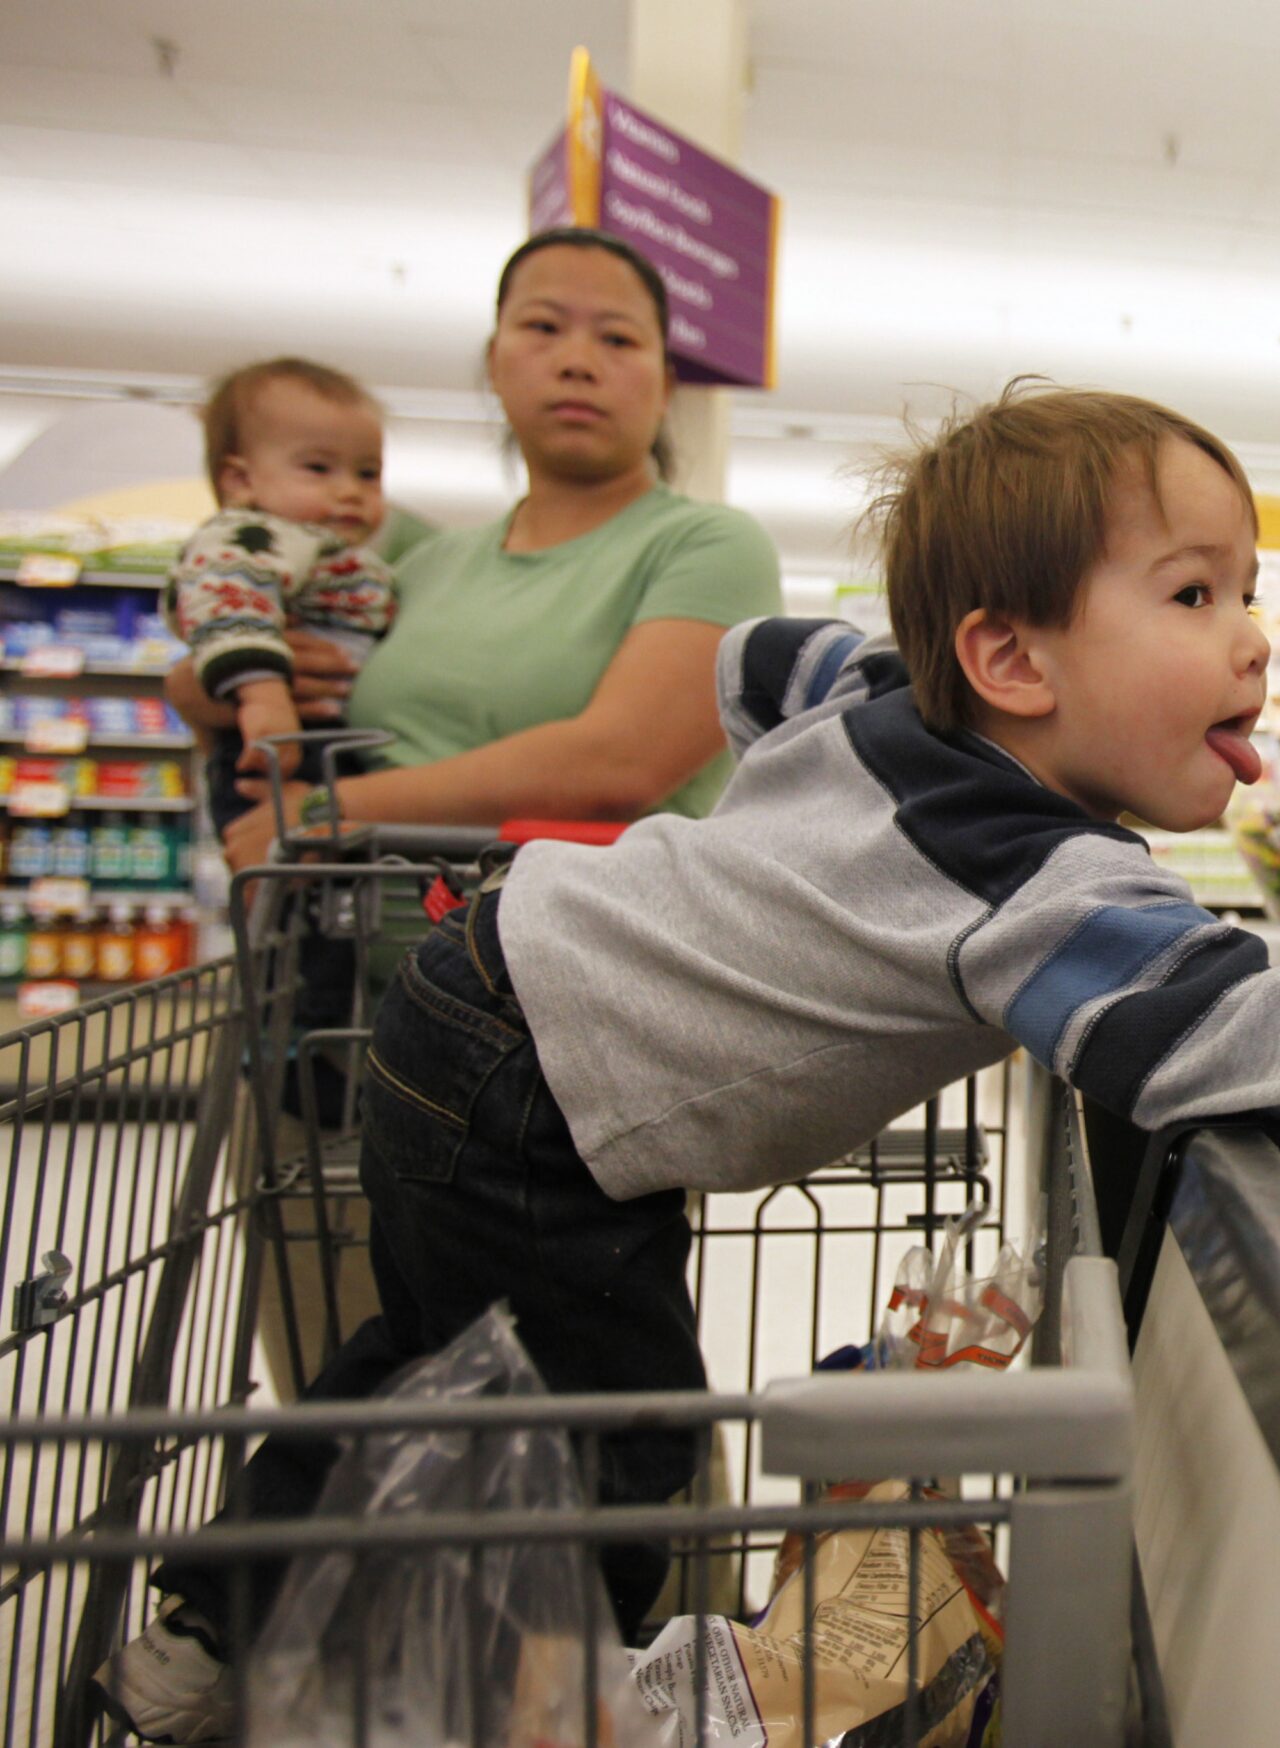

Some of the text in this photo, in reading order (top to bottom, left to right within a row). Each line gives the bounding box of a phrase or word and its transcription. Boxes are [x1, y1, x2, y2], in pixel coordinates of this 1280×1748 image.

[704, 1633, 742, 1739] VEGETARIAN SNACKS
[711, 1626, 751, 1732] OUR OTHER NATURAL
